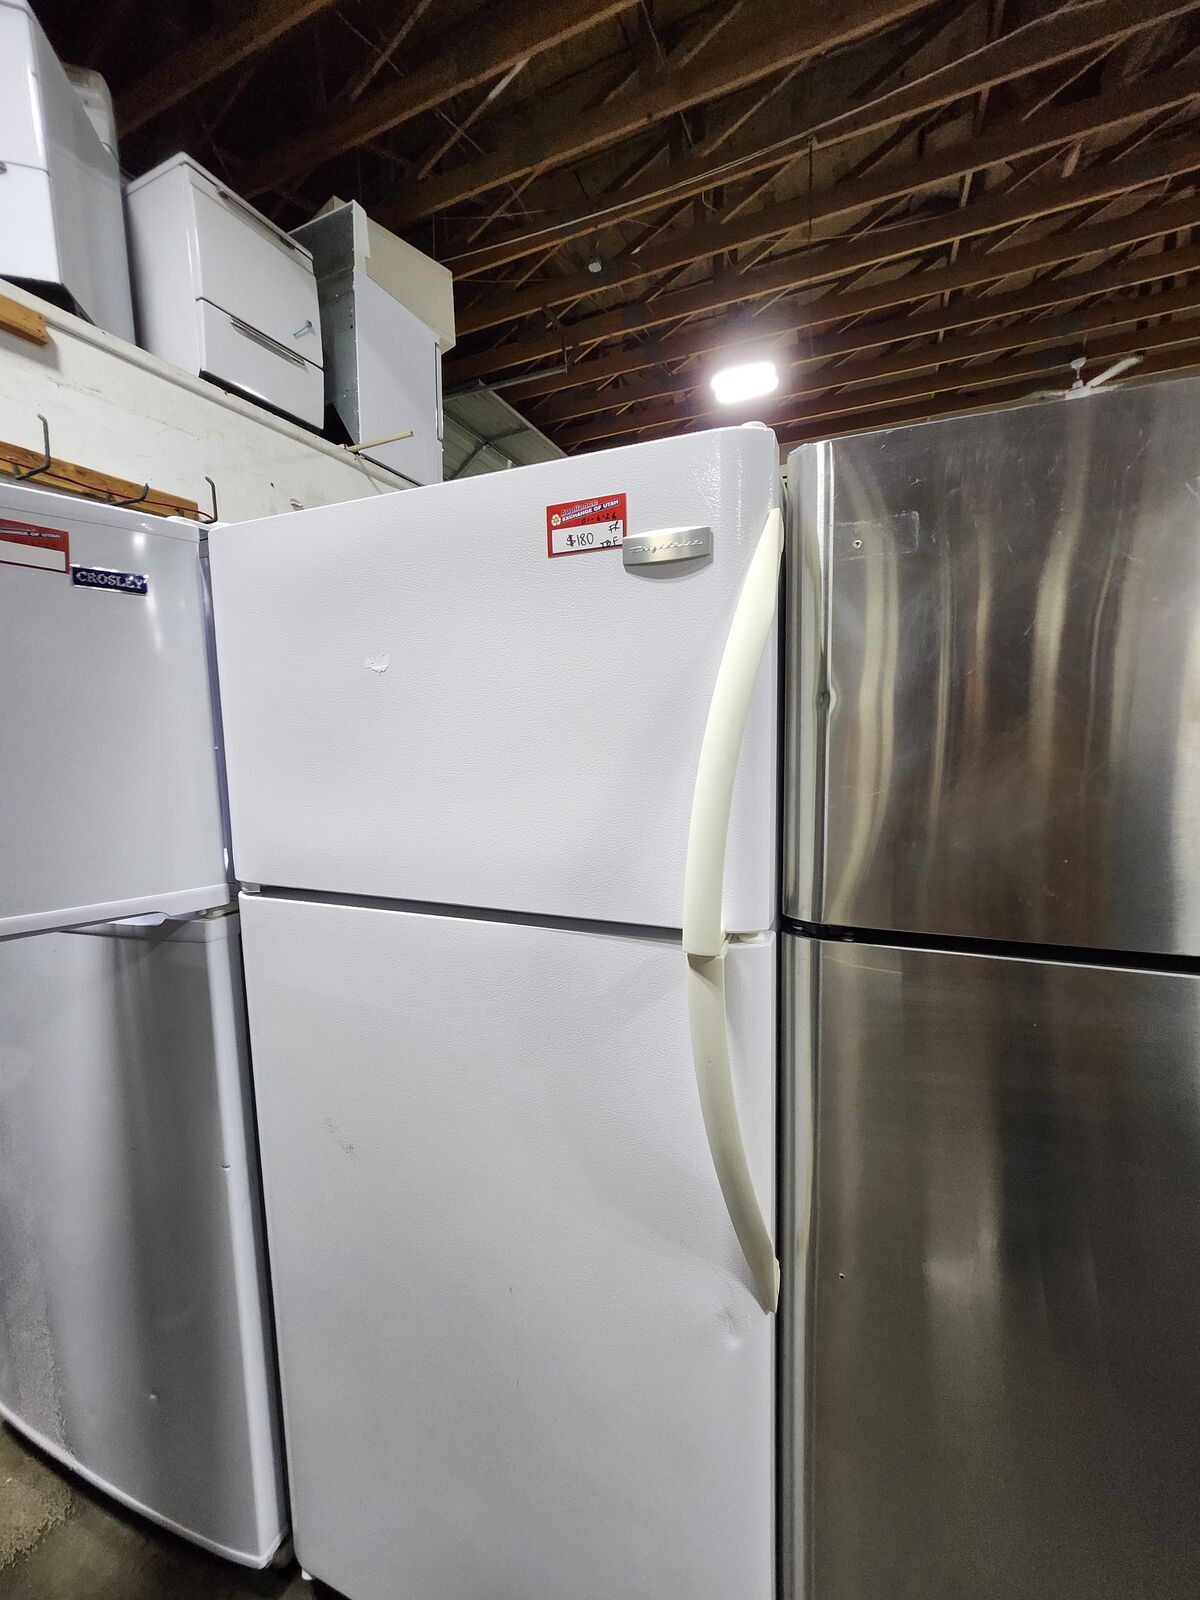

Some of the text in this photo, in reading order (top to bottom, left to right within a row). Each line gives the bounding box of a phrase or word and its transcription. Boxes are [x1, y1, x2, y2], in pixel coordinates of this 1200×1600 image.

[561, 499, 619, 522] EXCHANGE OF UTAH
[566, 532, 594, 547] $180
[75, 571, 144, 590] CROSLEY
